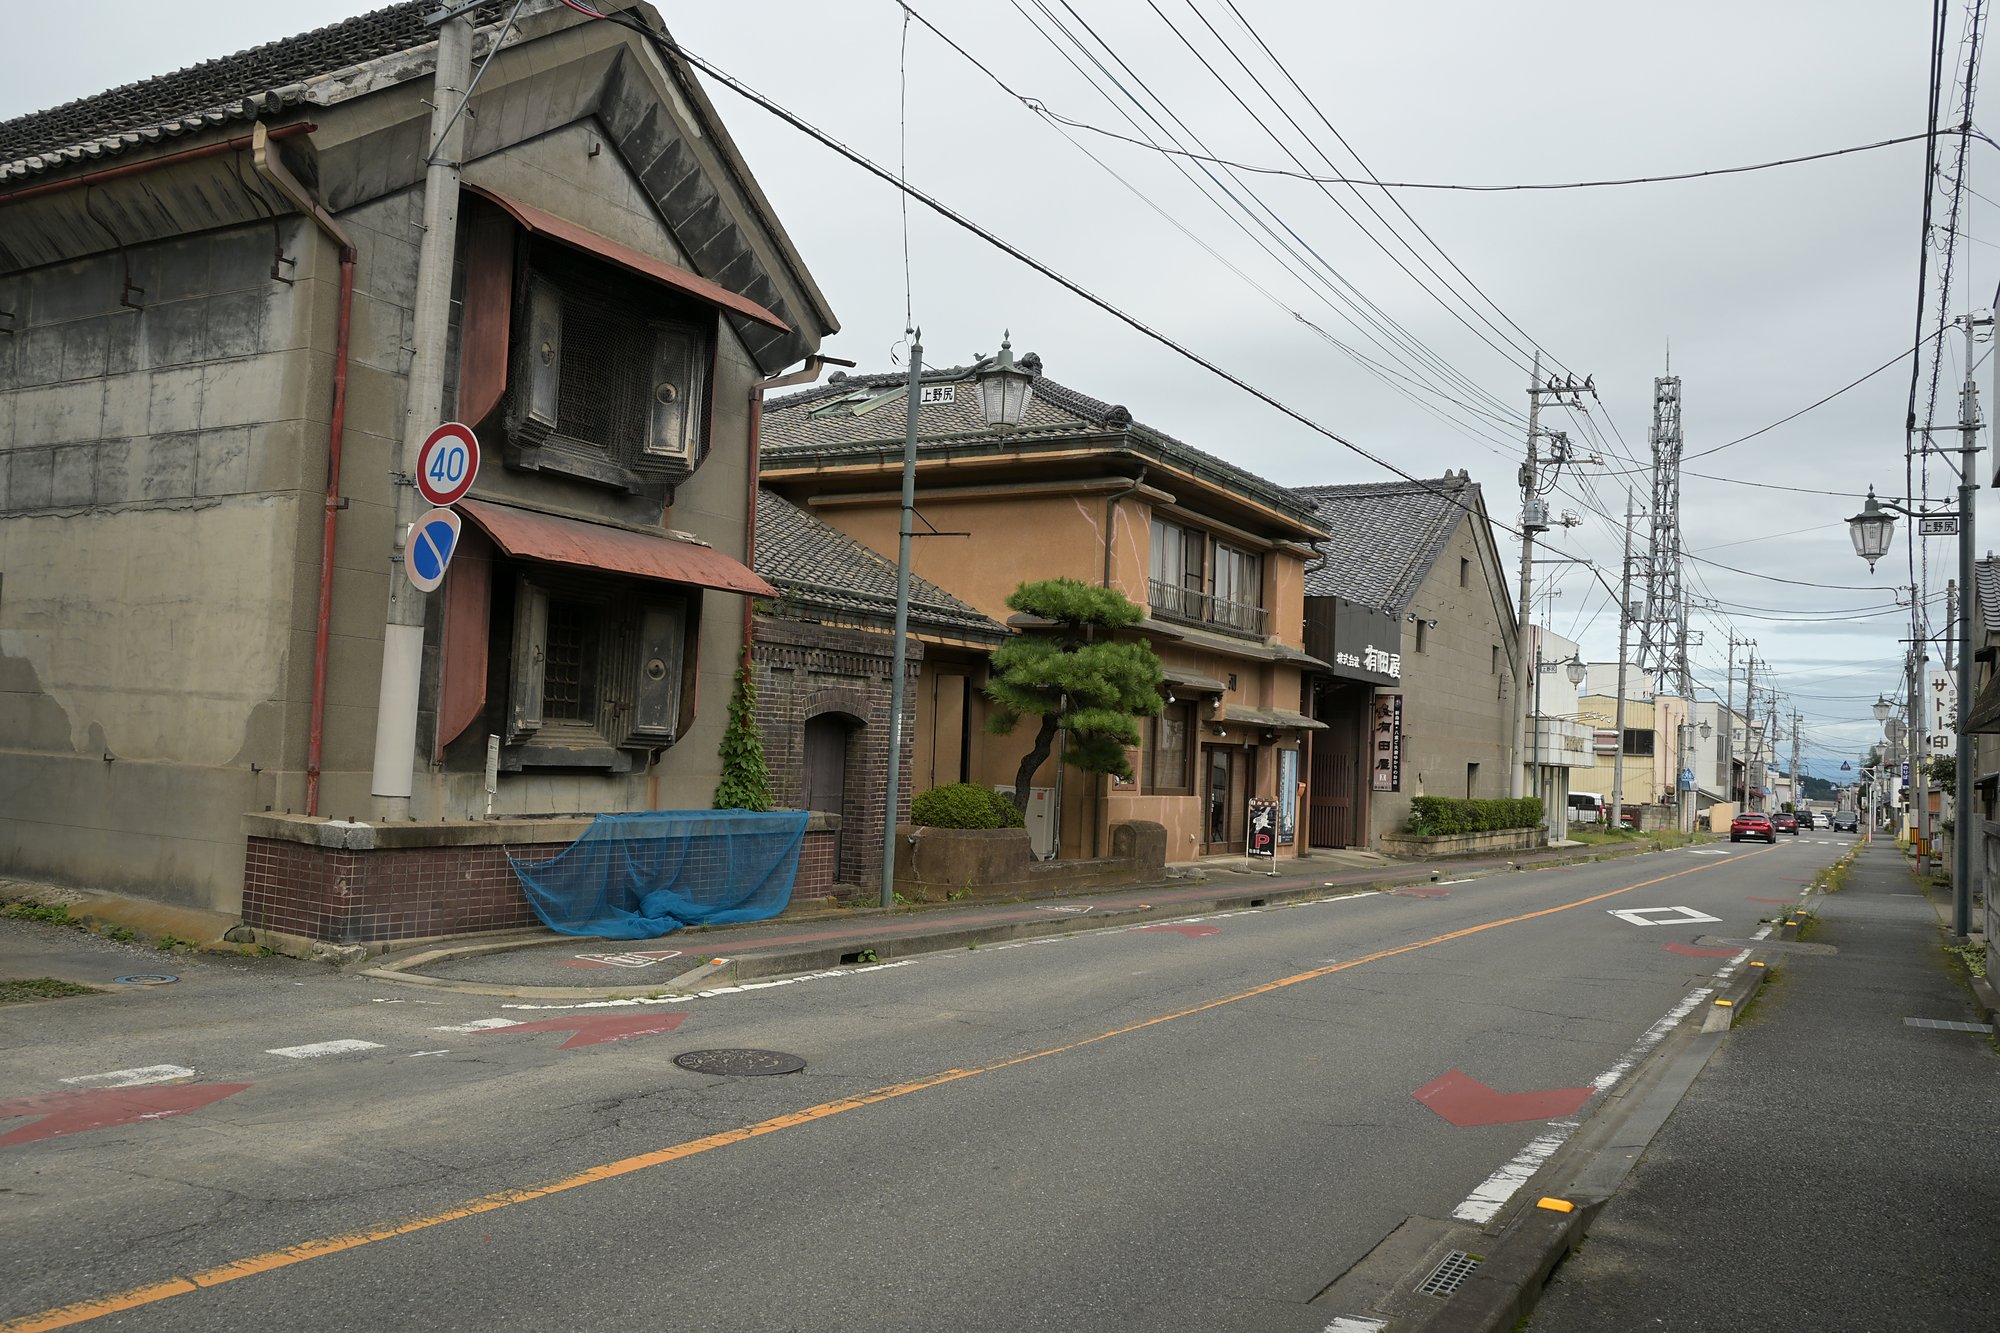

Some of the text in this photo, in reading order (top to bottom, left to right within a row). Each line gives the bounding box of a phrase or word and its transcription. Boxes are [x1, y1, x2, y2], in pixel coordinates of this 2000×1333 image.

[921, 387, 953, 403] 上野尻
[429, 447, 465, 482] 40
[1922, 521, 1955, 533] 上野尻
[1363, 644, 1401, 679] 有田屋
[1255, 833, 1270, 849] P
